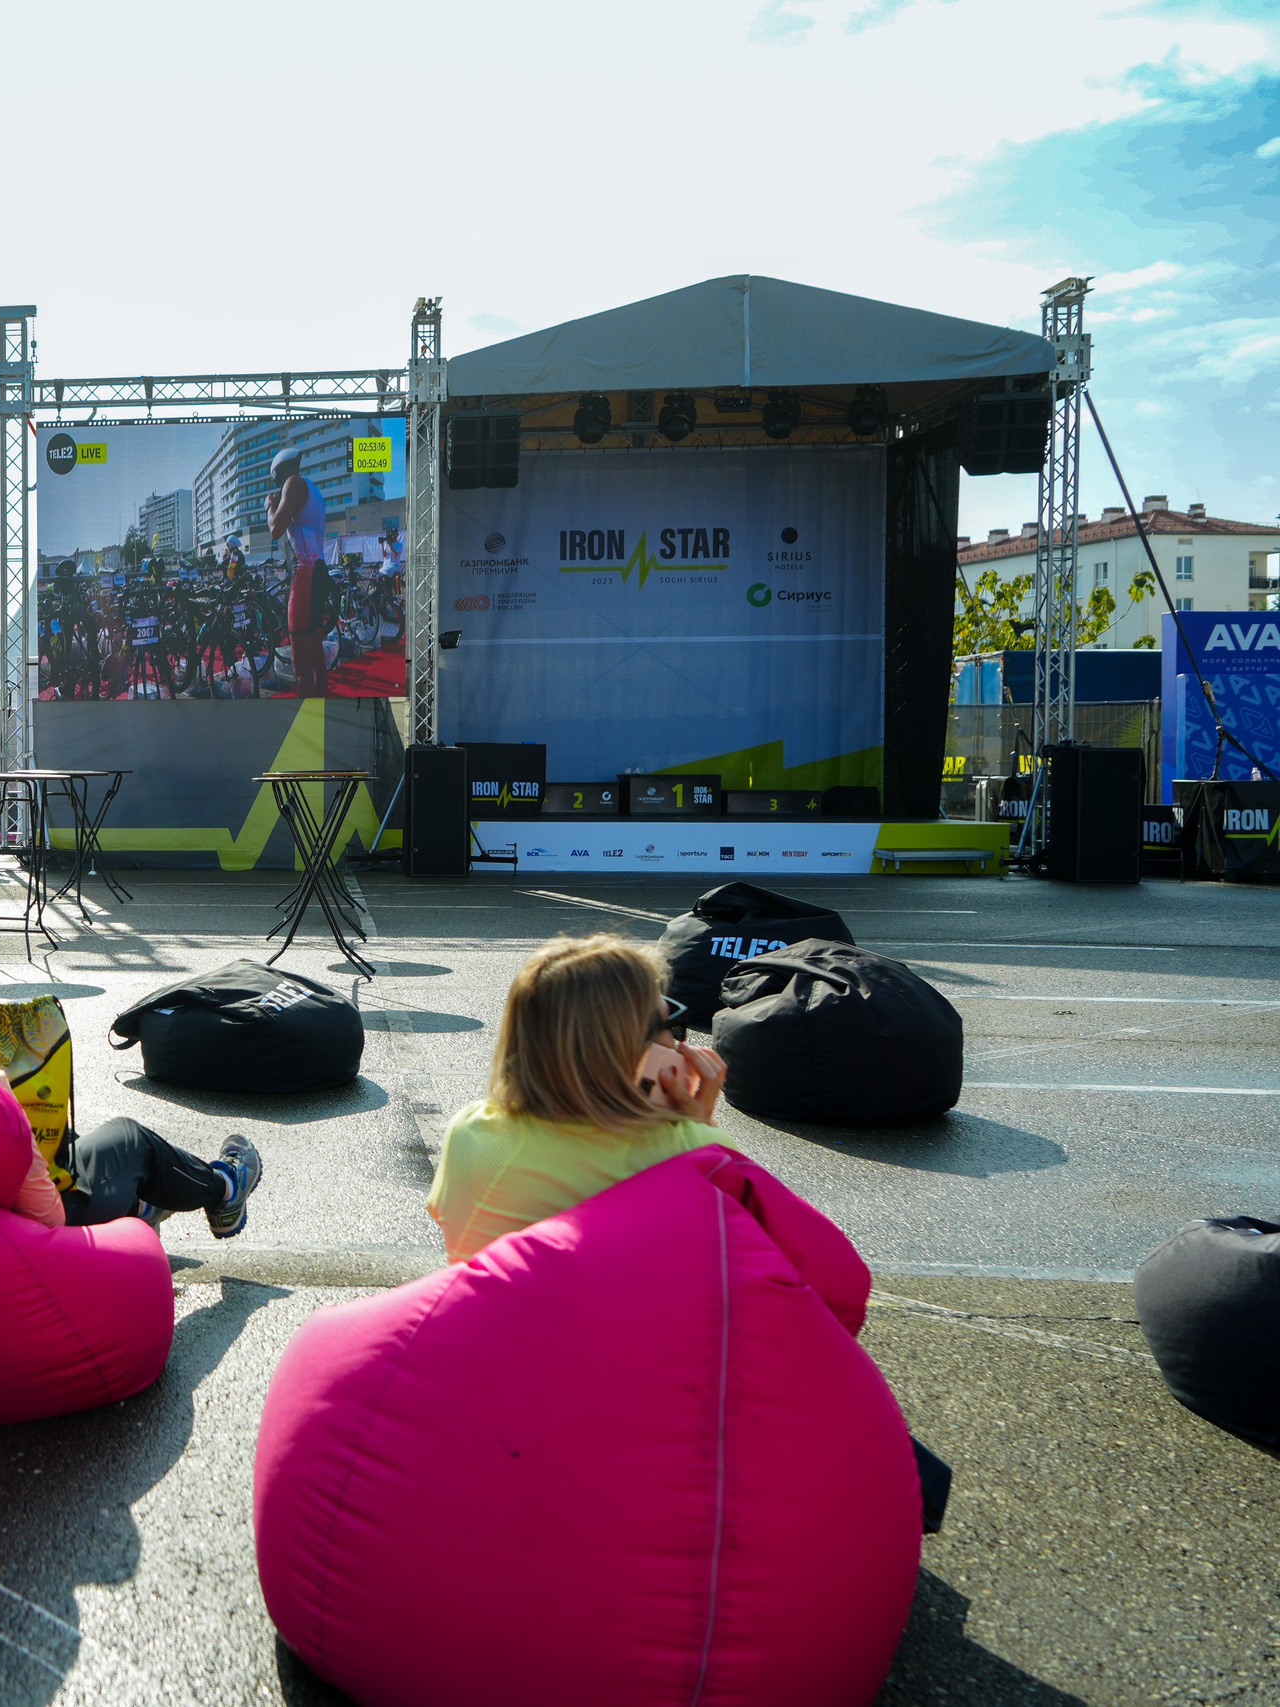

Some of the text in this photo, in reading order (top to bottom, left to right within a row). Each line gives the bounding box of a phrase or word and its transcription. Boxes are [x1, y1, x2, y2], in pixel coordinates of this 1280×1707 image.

[49, 446, 101, 459] TELE2 LIVE
[358, 442, 386, 452] 02:53:16
[357, 459, 388, 469] 00:52:49
[559, 527, 731, 561] IRON STAR
[767, 551, 812, 561] SIRIUS
[460, 558, 529, 568] ГАЗПРОМБАНК
[472, 567, 518, 575] ПРЕМИУМ
[592, 577, 613, 585] 2023
[777, 590, 832, 603] Сириус
[136, 627, 155, 639] 2067
[1204, 623, 1280, 651] AVA
[472, 781, 540, 797] IRON STAR
[694, 786, 708, 794] IRON
[573, 792, 584, 809] 2
[671, 783, 684, 808] 1
[693, 794, 713, 804] STAR
[769, 798, 778, 811] 3
[1223, 809, 1270, 831] IRON
[1143, 821, 1174, 843] IRO
[602, 849, 623, 857] TELE2
[680, 850, 708, 858] sports.ru
